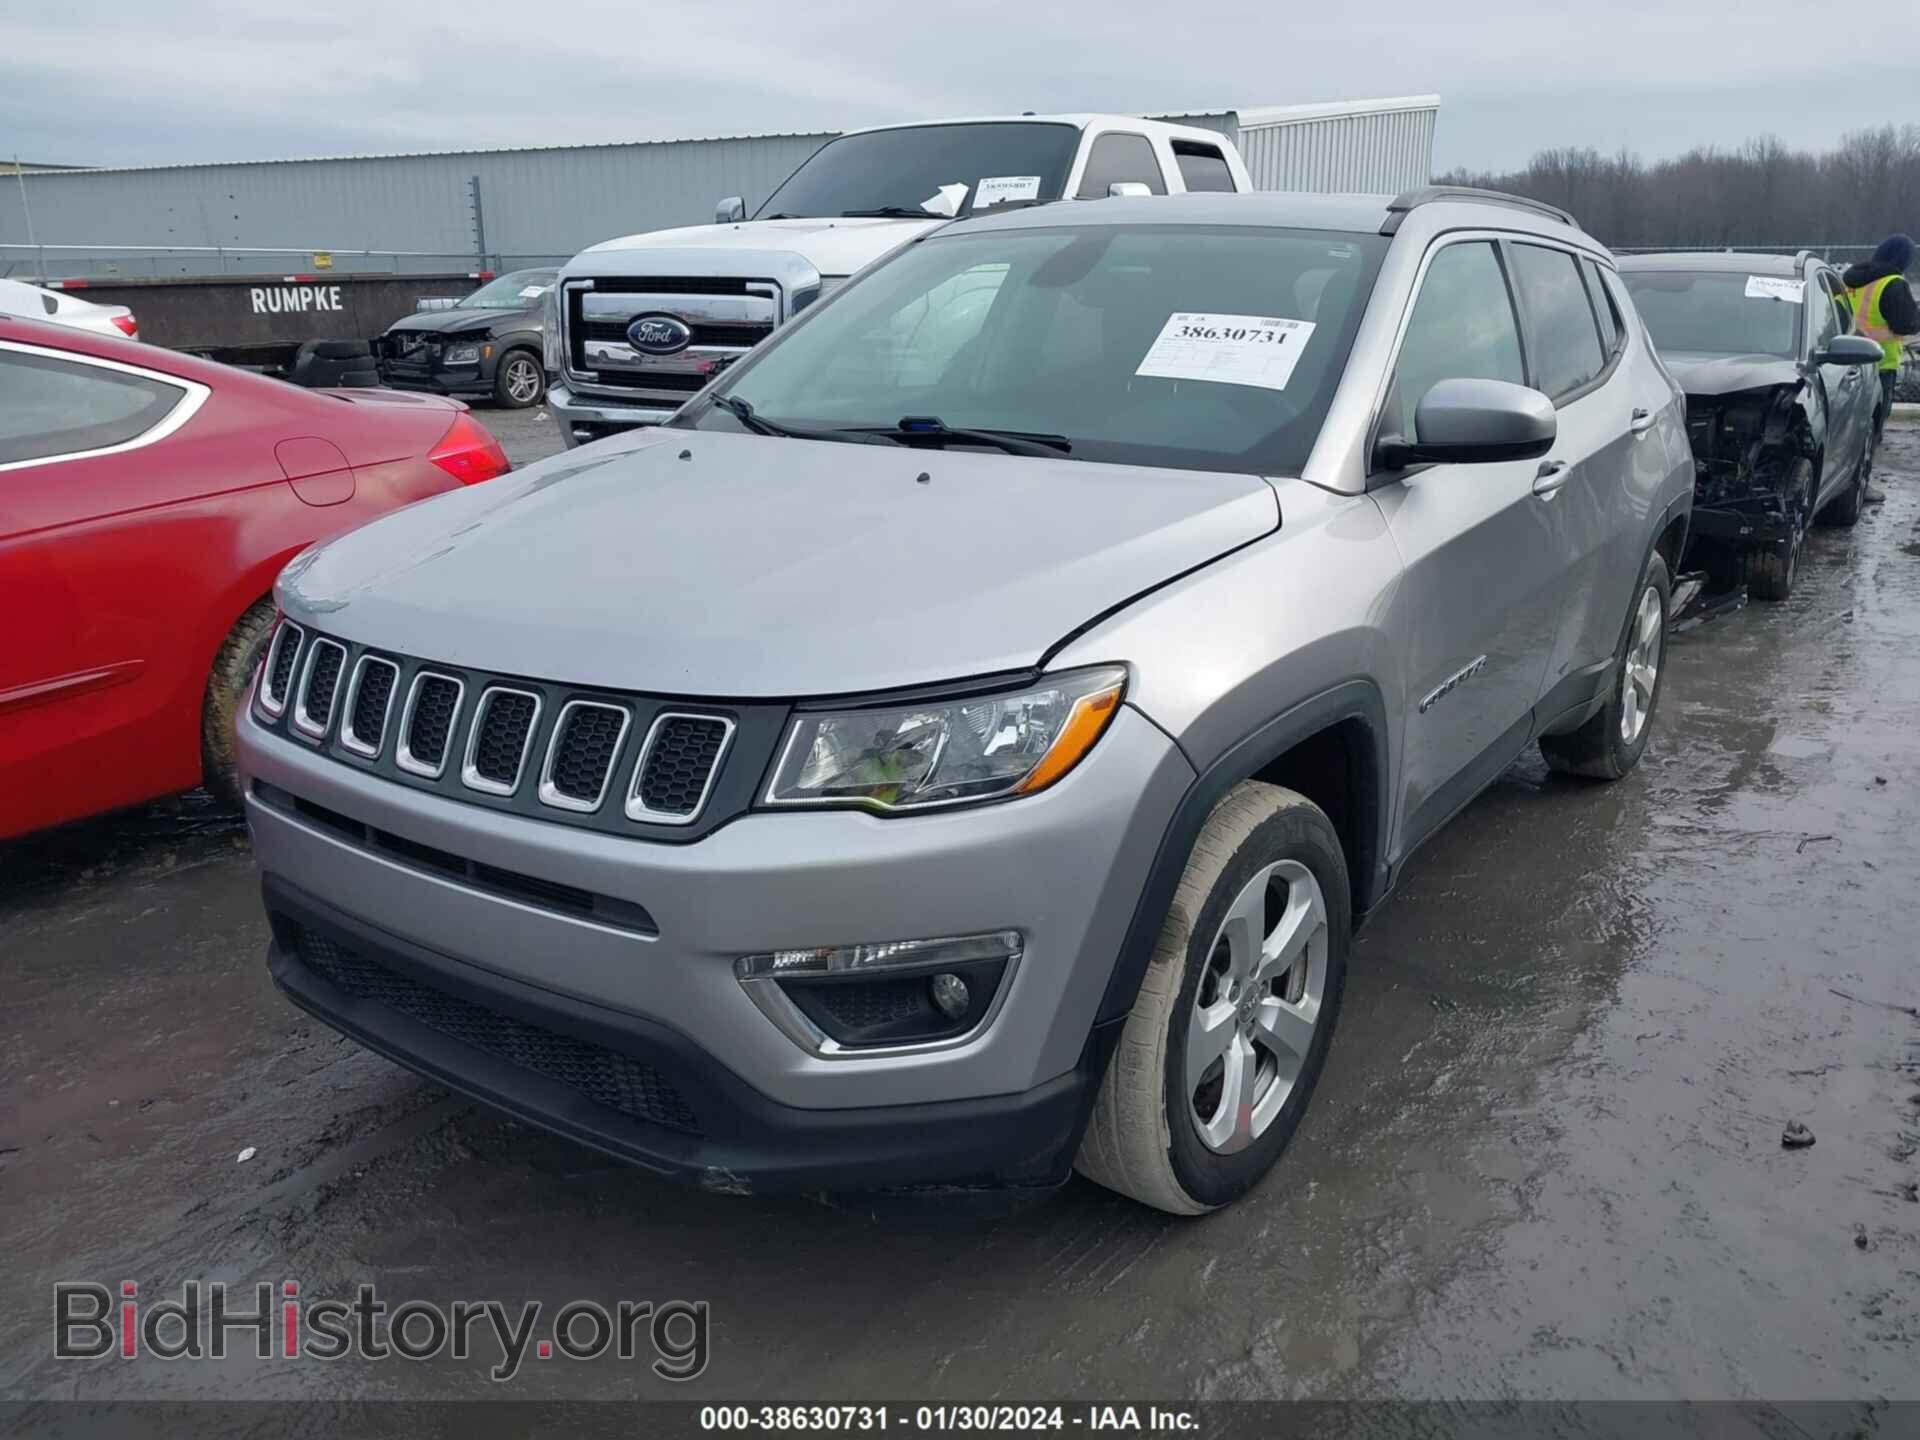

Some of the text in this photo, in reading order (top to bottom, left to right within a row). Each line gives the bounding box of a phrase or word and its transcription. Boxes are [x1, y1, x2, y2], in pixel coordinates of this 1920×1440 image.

[250, 286, 343, 313] RUMPKE
[638, 322, 672, 343] Ford
[1174, 325, 1287, 344] 38630731
